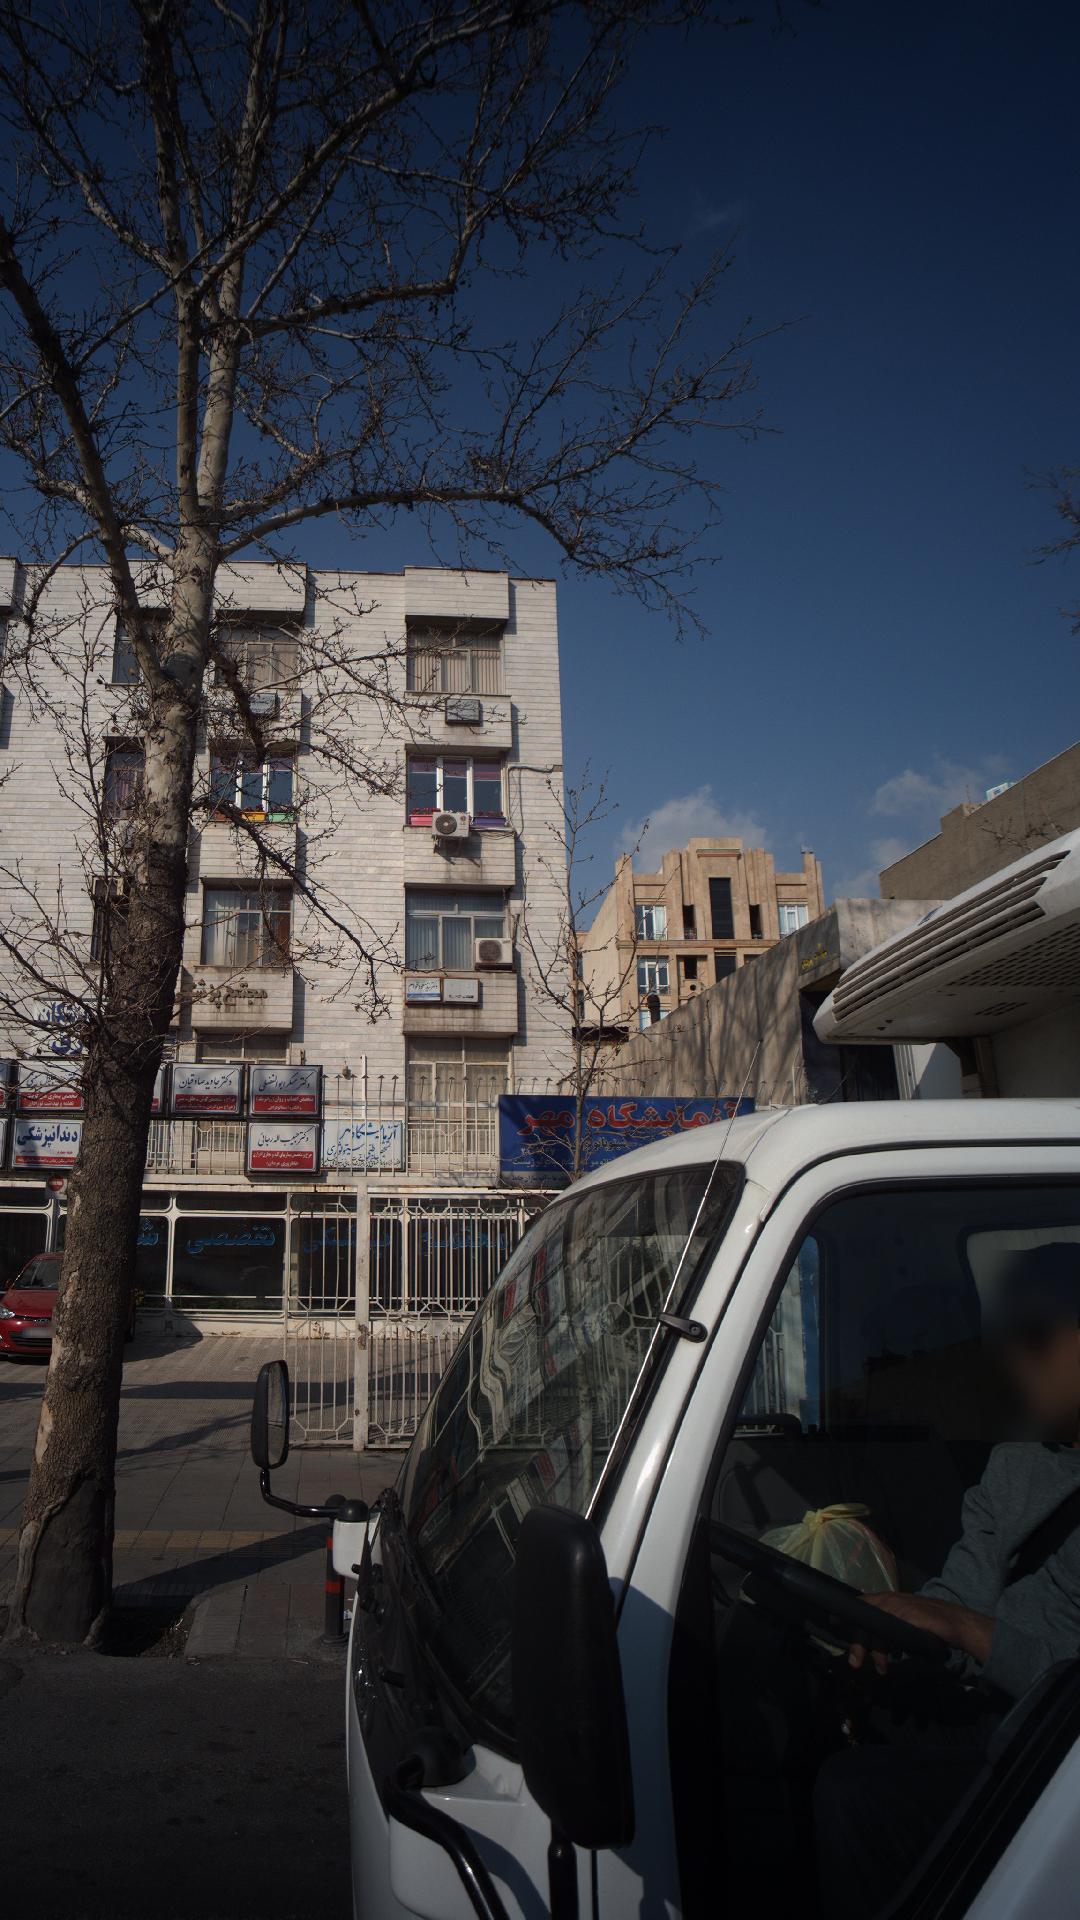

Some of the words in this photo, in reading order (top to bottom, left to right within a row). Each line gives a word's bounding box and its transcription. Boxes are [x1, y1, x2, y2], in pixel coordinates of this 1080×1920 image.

[179, 1073, 204, 1089] صادقیان
[205, 1076, 219, 1090] جاوید
[218, 1069, 238, 1089] دکتر
[296, 1071, 314, 1090] دکتر
[515, 1110, 576, 1136] مهر
[17, 1123, 78, 1148] دندانپزشکی
[296, 1125, 314, 1146] دکتر
